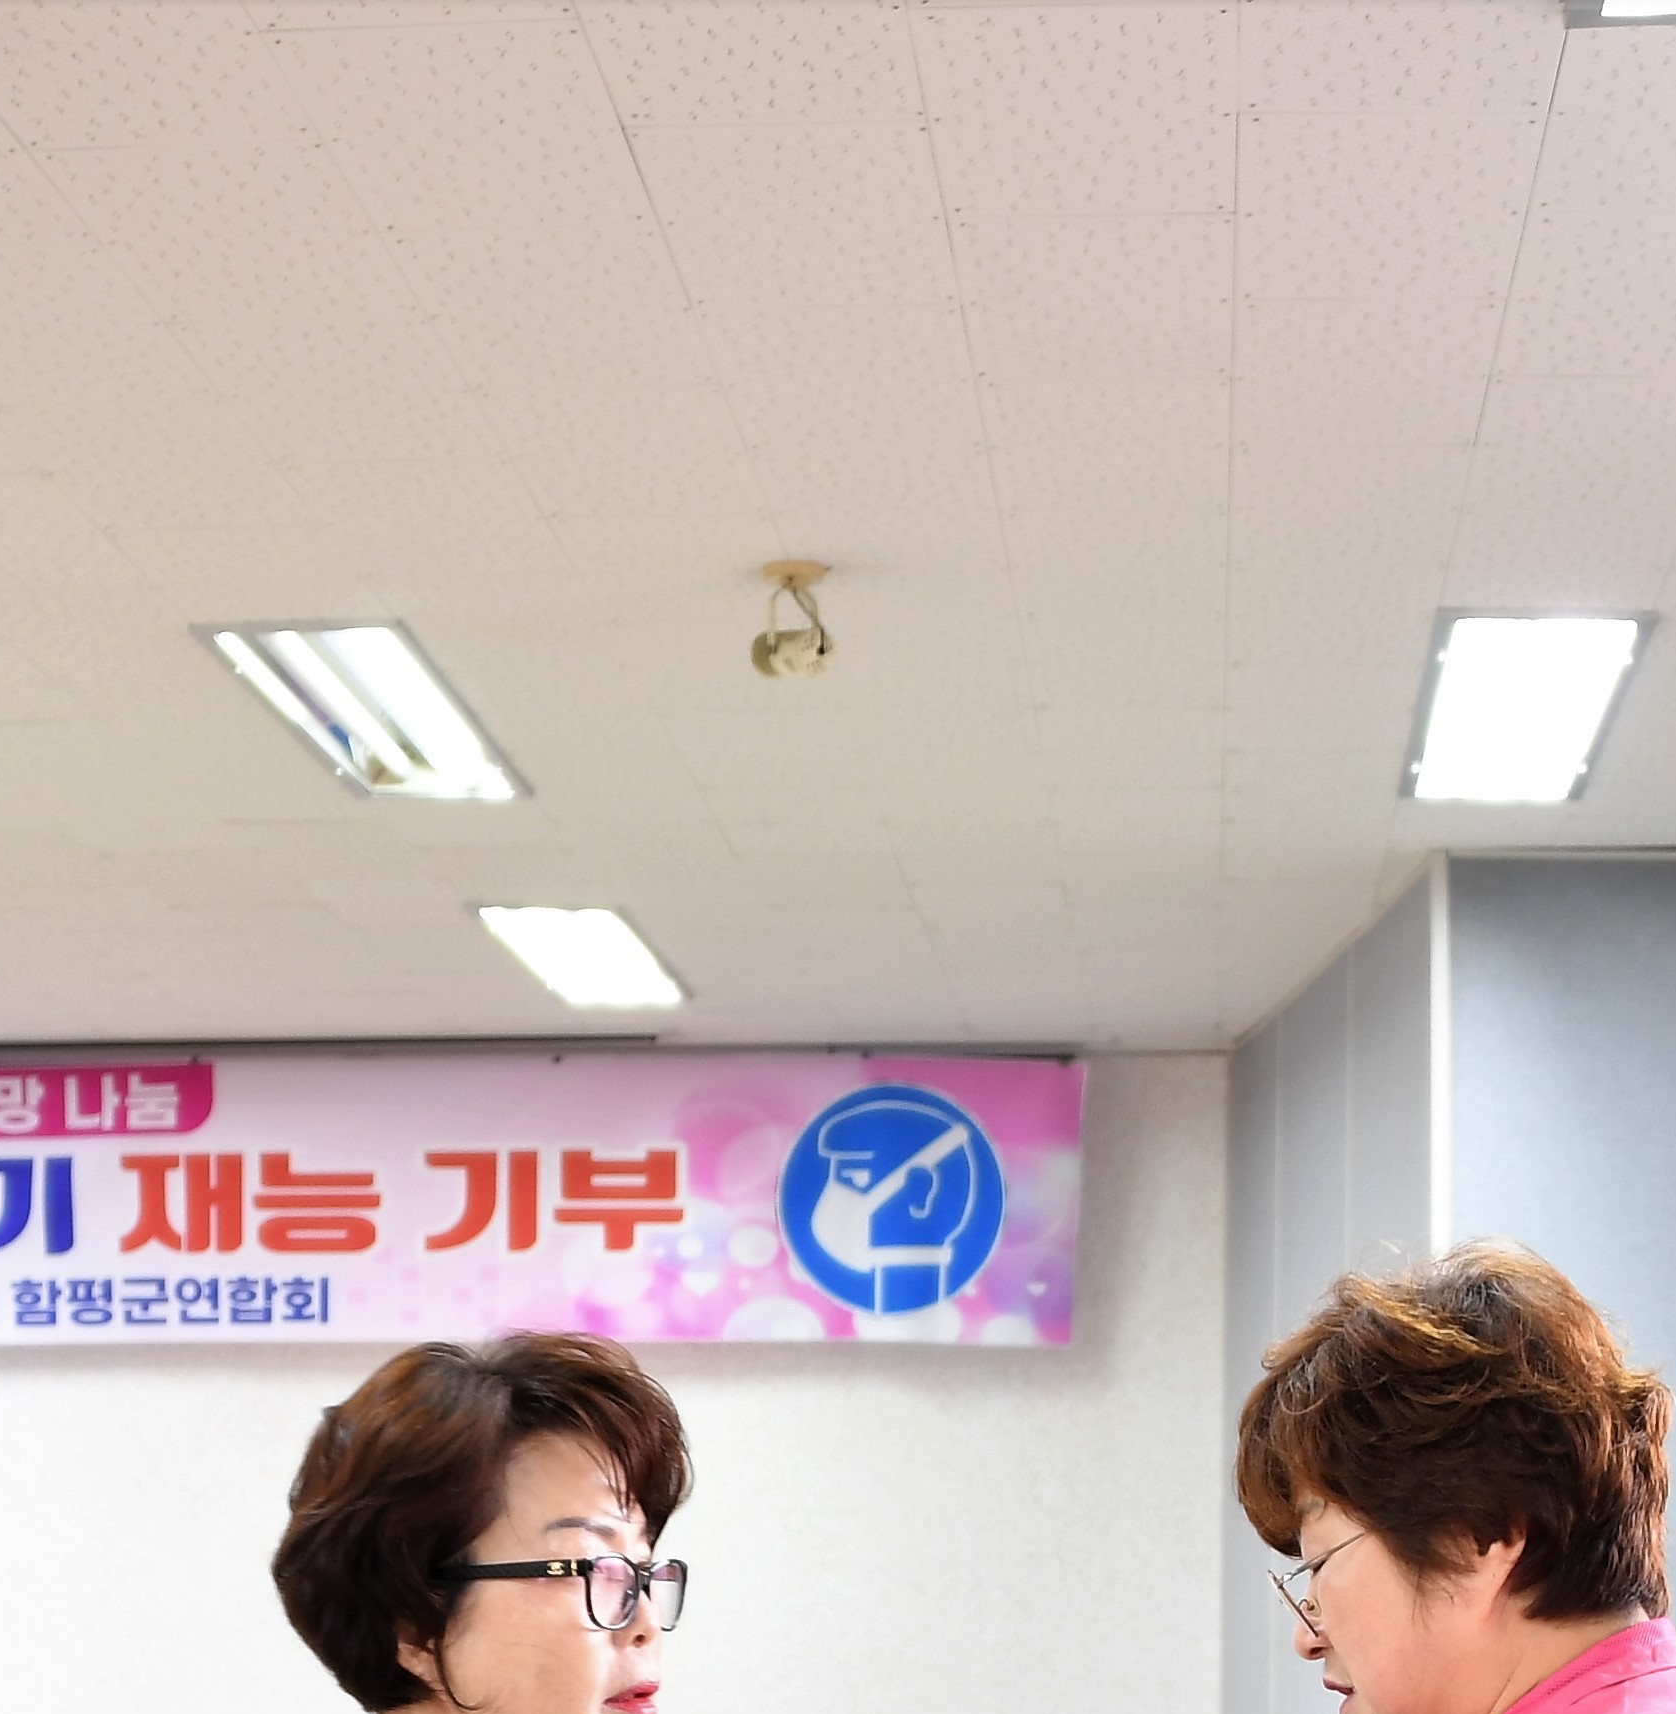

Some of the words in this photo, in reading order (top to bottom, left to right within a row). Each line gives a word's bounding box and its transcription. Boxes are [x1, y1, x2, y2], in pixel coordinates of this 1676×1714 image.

[63, 1072, 180, 1132] 나눔
[117, 1151, 381, 1254] 재능
[422, 1150, 685, 1253] 기부
[11, 1275, 329, 1328] 함평군연합회
